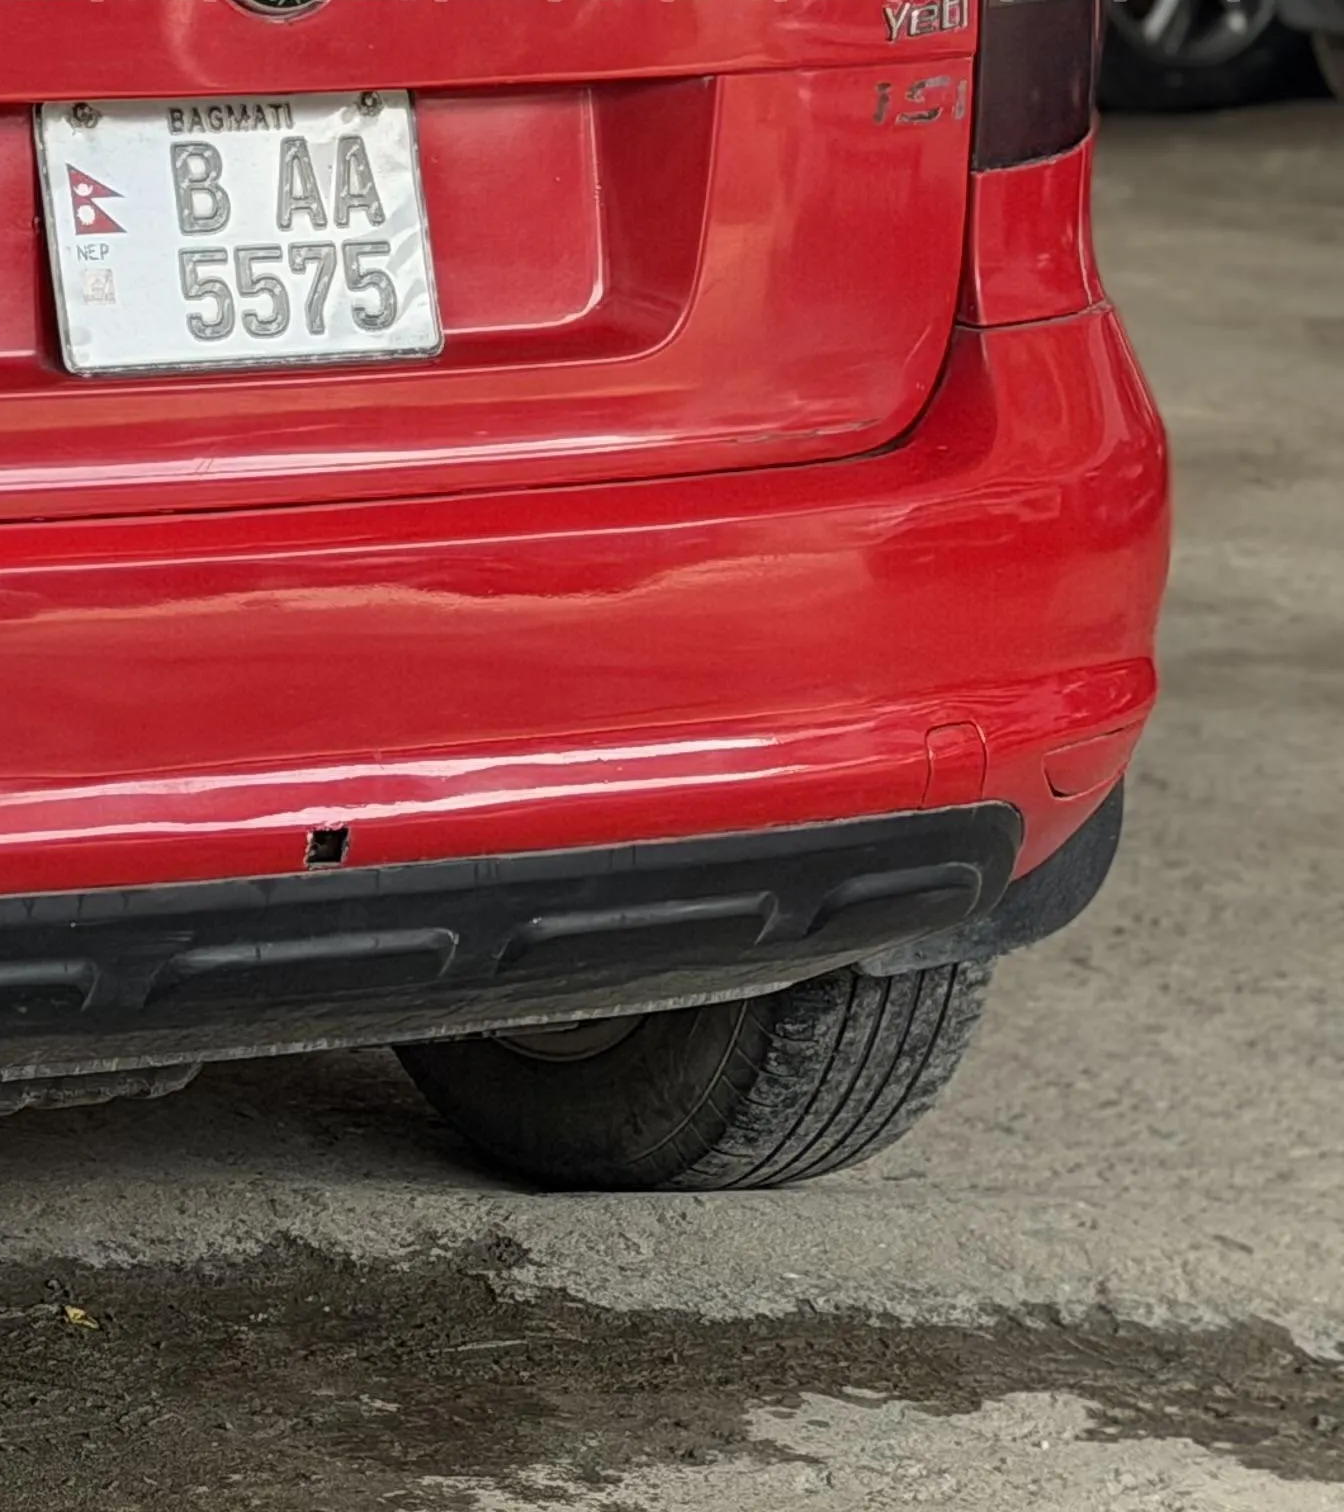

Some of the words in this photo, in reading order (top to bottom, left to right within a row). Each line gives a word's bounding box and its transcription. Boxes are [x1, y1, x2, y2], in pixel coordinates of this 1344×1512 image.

[167, 100, 294, 135] BAGMATI
[168, 140, 231, 237] B
[276, 134, 385, 232] AA
[76, 243, 110, 262] NEP
[177, 240, 398, 343] 5575
